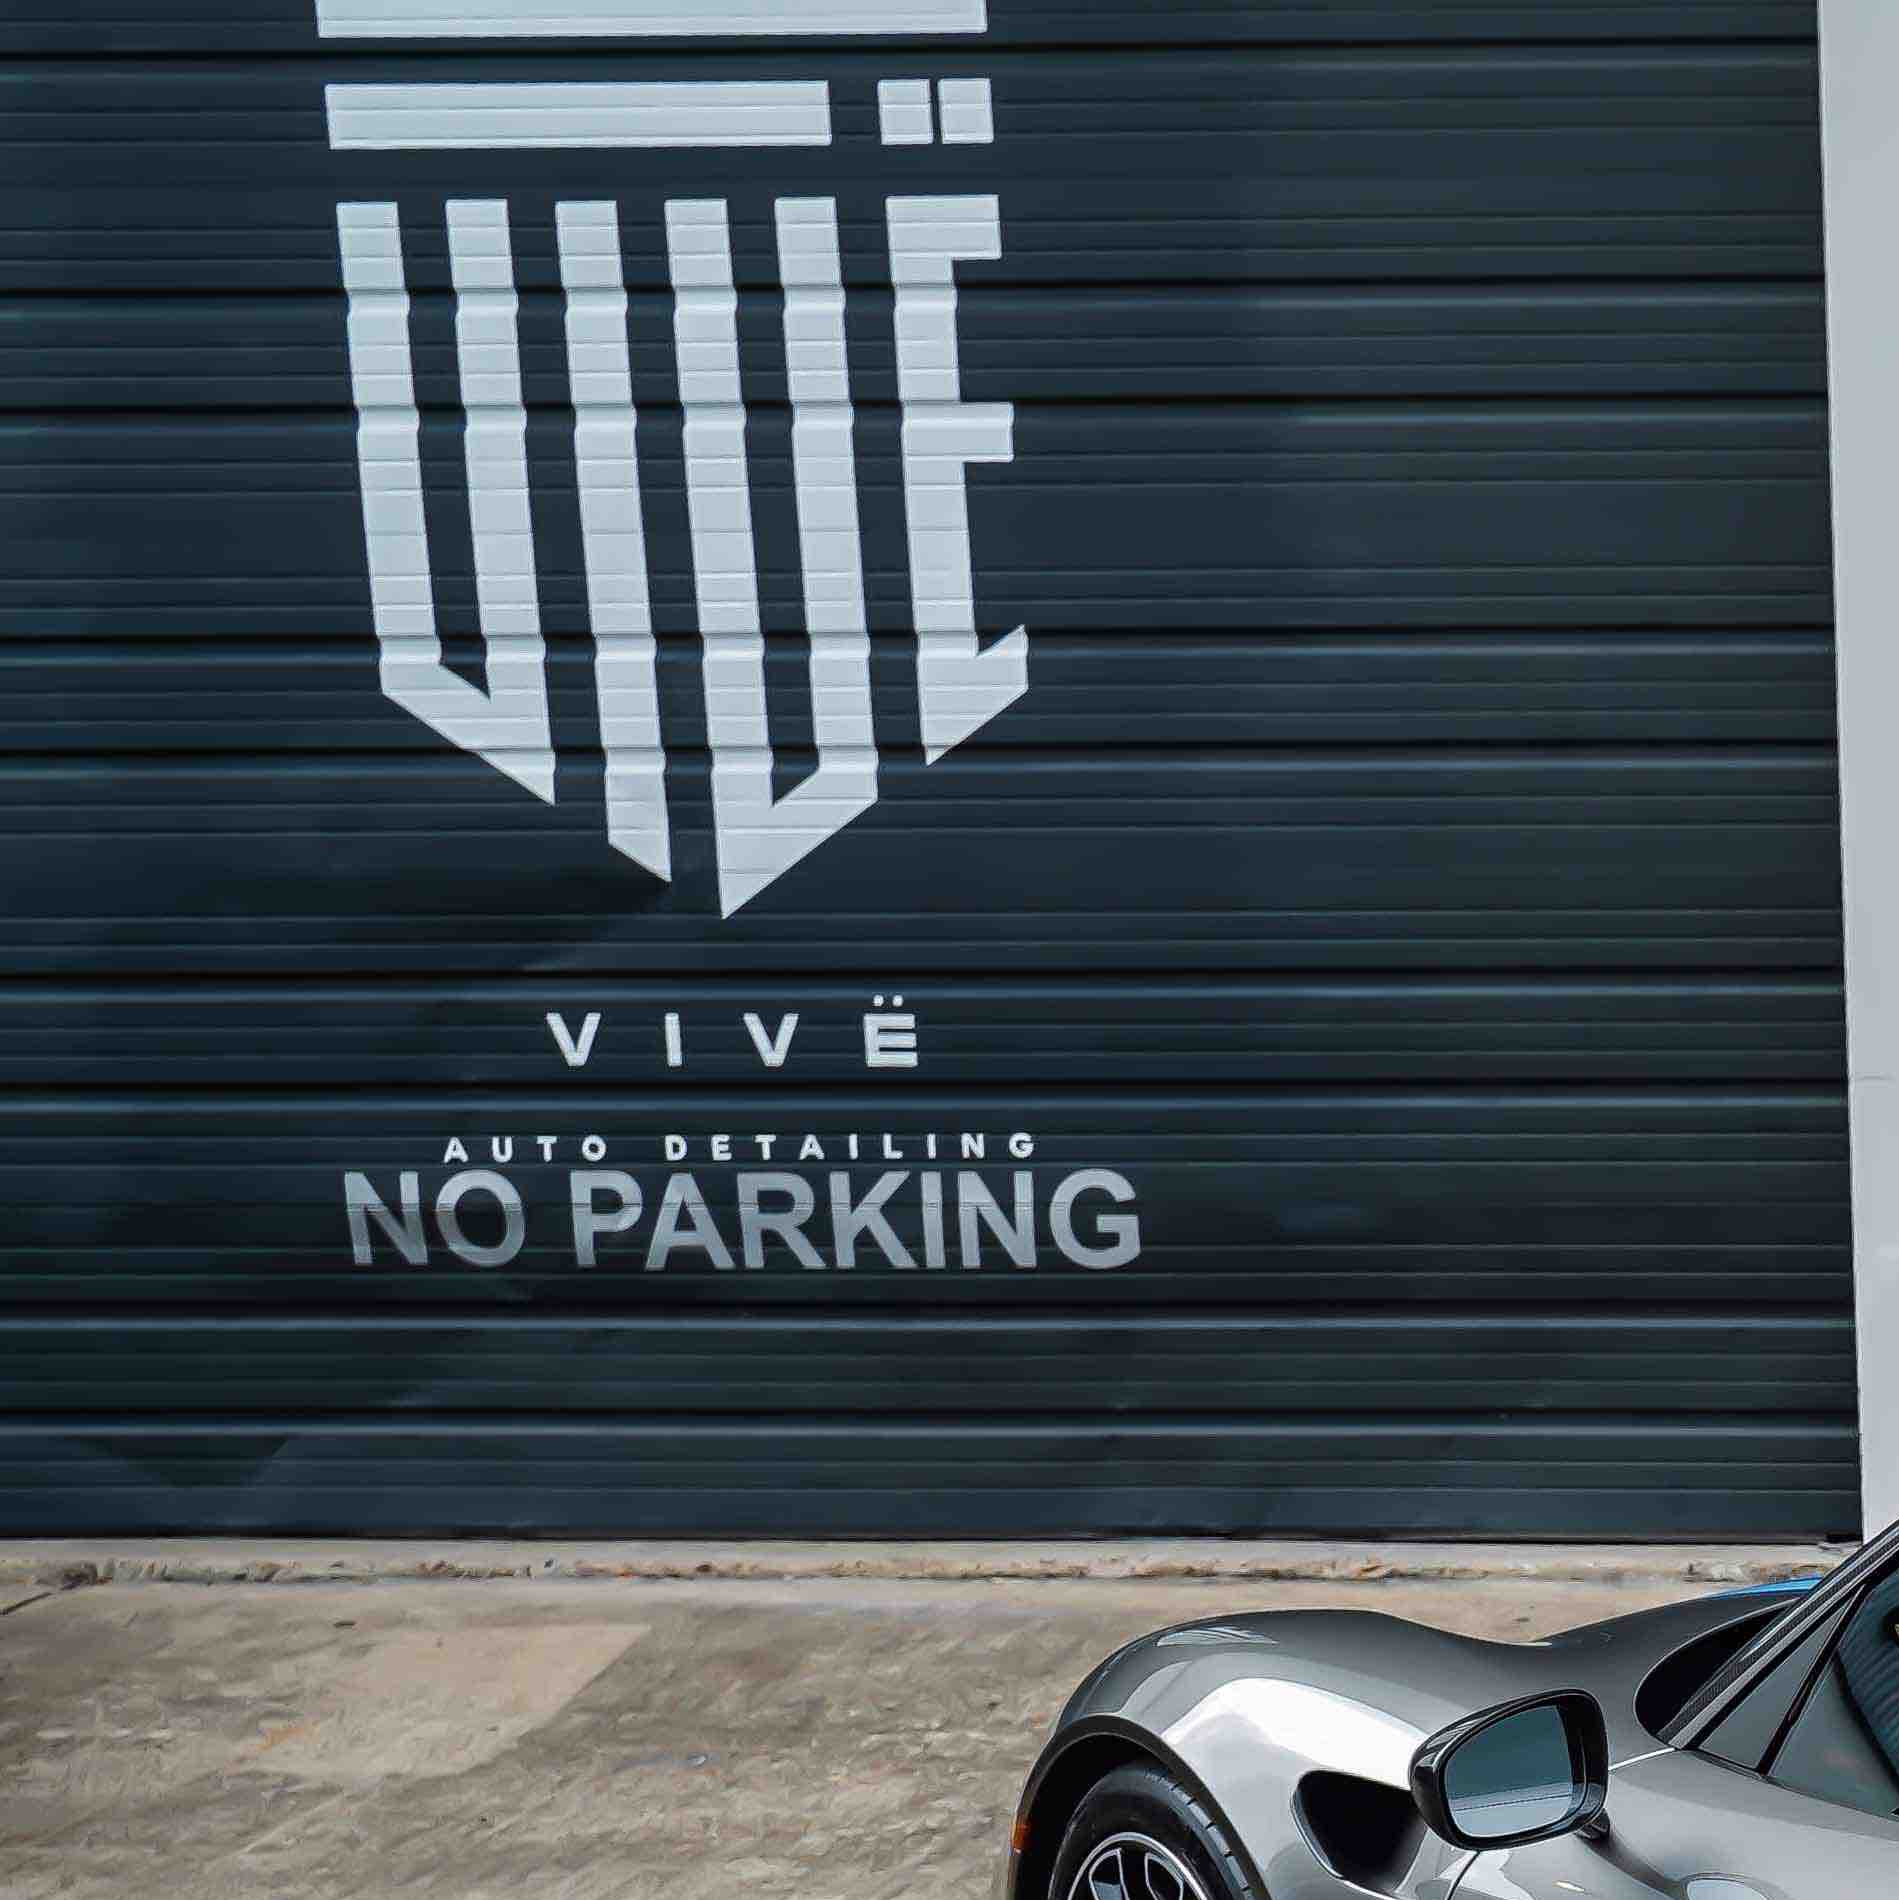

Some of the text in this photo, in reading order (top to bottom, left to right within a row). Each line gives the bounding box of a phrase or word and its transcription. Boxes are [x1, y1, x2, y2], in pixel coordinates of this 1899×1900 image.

[442, 1131, 1037, 1163] AUTO DETAILING
[343, 1167, 1143, 1272] NO PARKING
